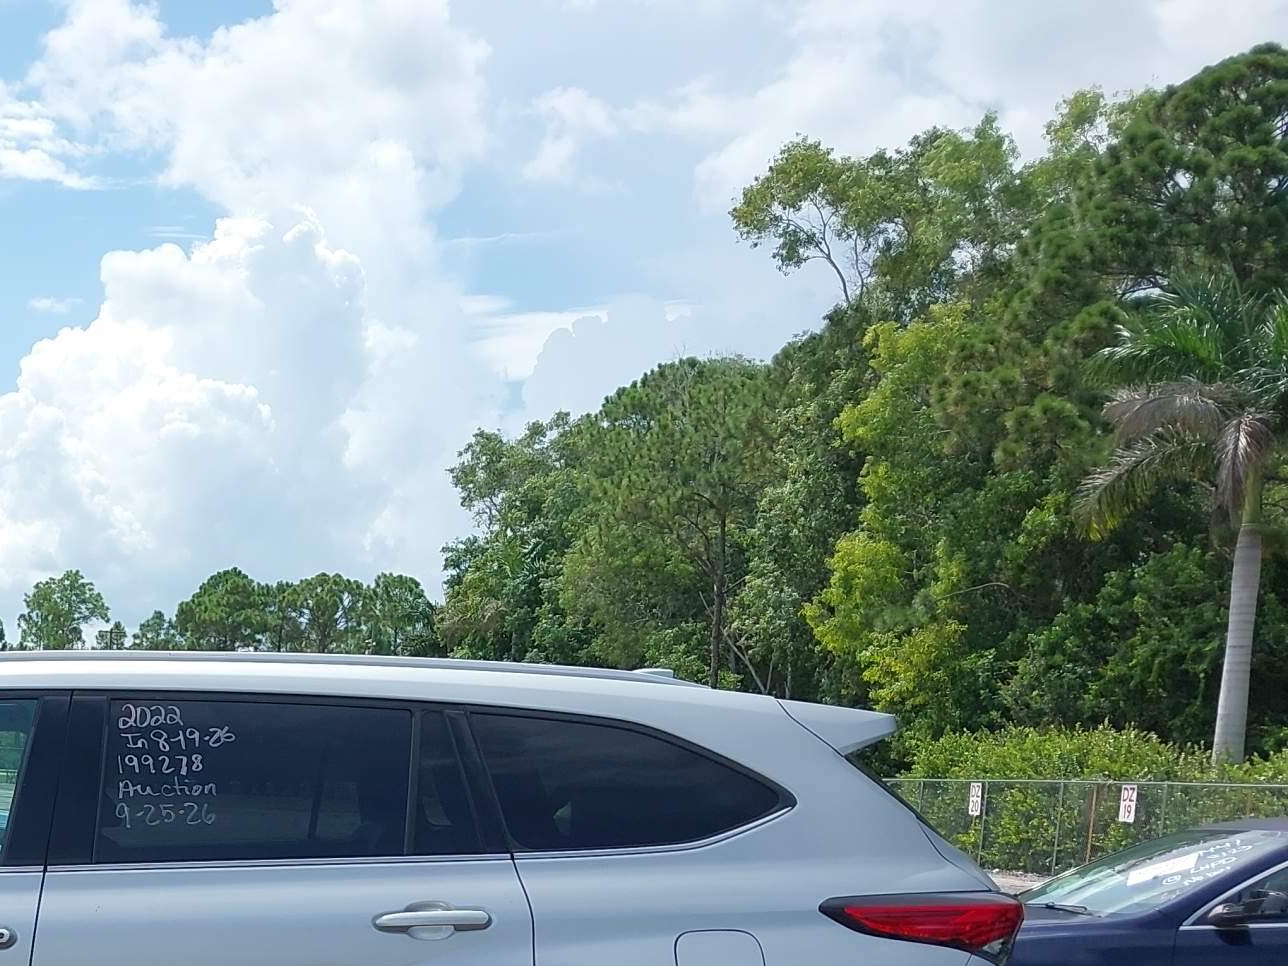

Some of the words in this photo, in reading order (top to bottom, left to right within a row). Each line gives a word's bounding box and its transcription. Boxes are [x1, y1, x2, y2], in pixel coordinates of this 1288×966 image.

[118, 703, 184, 729] 2022
[120, 733, 149, 749] In
[118, 754, 204, 776] 199278
[118, 775, 217, 799] Auction
[970, 784, 980, 798] DZ
[1122, 787, 1136, 802] DZ
[970, 799, 979, 812] 20
[1123, 804, 1132, 819] 19
